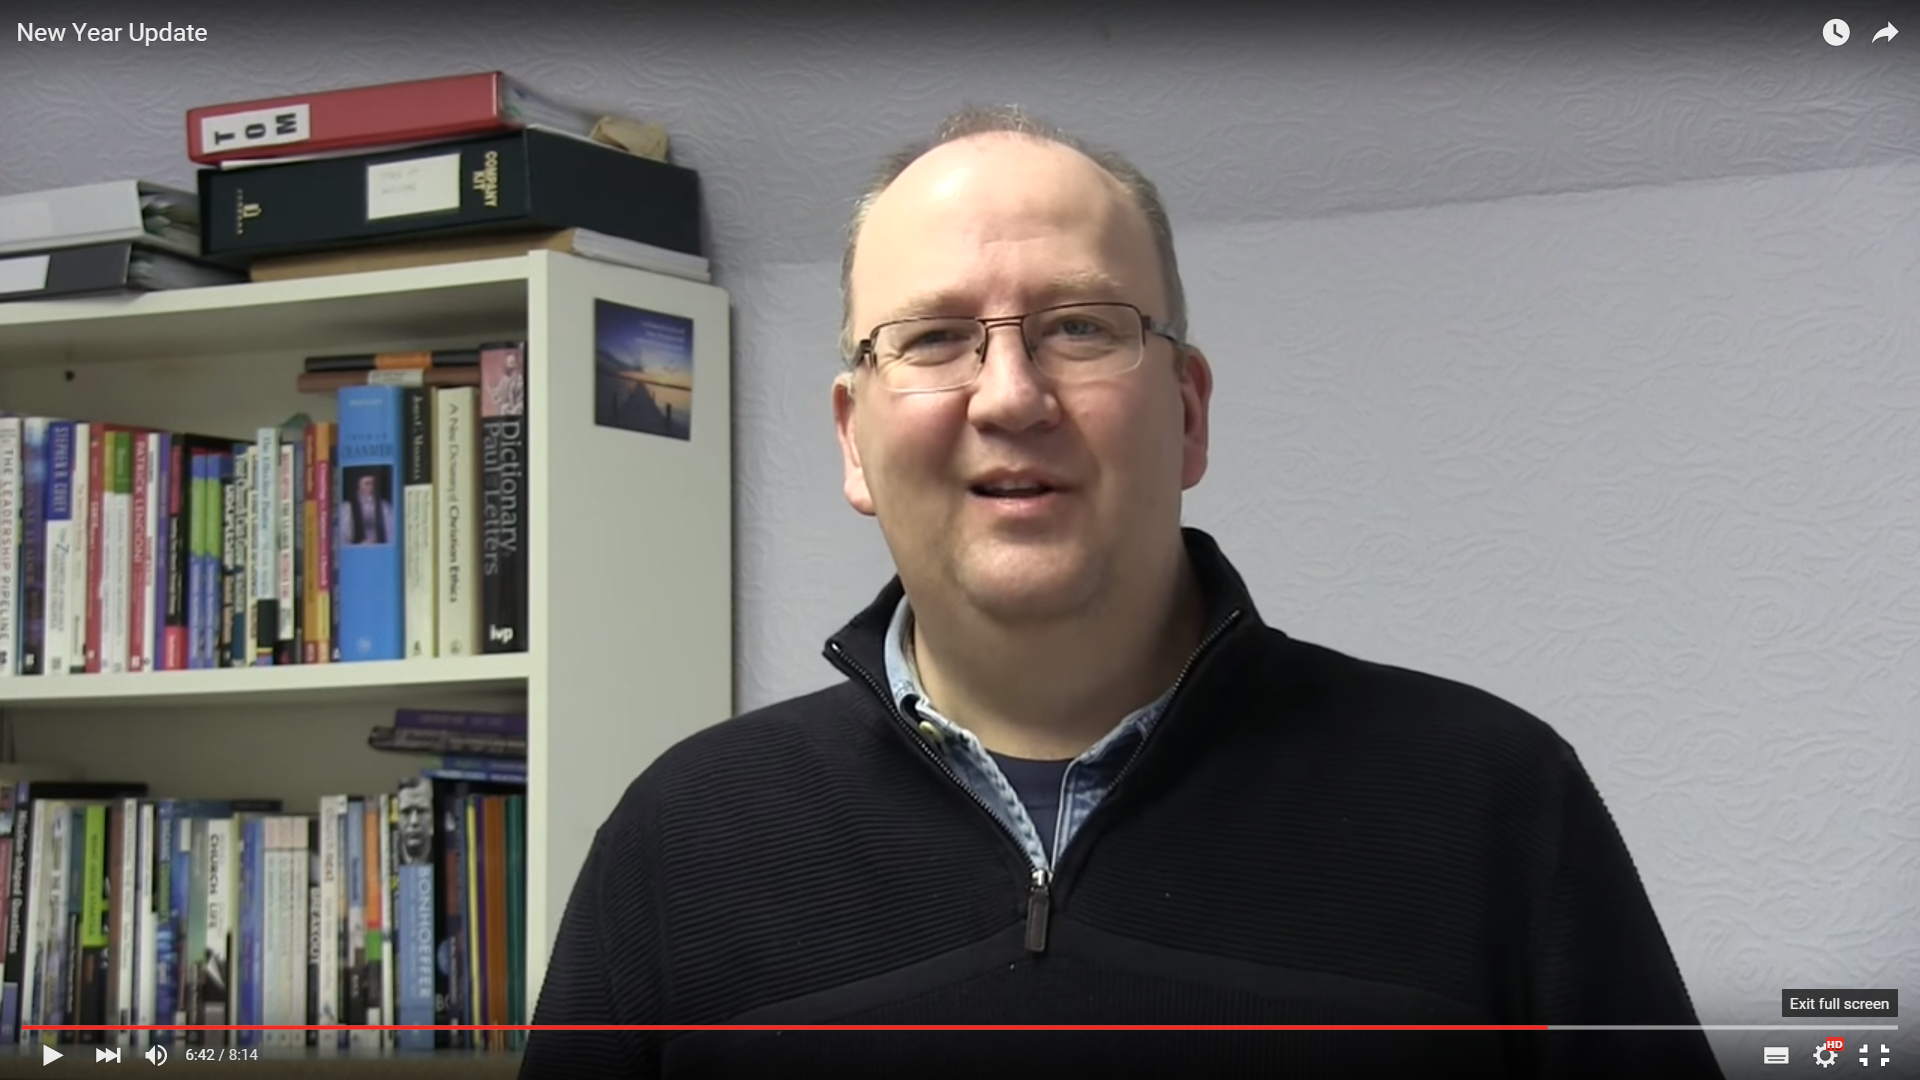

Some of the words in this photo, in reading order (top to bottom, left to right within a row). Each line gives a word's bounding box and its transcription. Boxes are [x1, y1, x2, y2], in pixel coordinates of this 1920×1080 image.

[473, 170, 485, 191] KIT
[485, 150, 499, 207] COMPANY
[448, 417, 460, 441] New
[449, 403, 460, 417] A
[3, 448, 14, 475] THE
[54, 427, 70, 469] STEPHEN
[135, 441, 147, 494] PATRICK
[446, 444, 459, 494] Dictionary
[483, 422, 502, 473] Paul
[54, 482, 69, 514] COVEY
[234, 479, 247, 515] Church
[261, 455, 272, 497] Effective
[498, 421, 522, 550] Dictionary
[2, 480, 13, 570] LEADERSHIP
[56, 541, 70, 555] 7
[134, 498, 145, 564] LENCIONI
[448, 505, 460, 564] Christian
[483, 490, 502, 576] Letters
[0, 575, 11, 640] PIPELINE
[449, 565, 461, 603] Ethics
[489, 624, 515, 646] ivp
[12, 809, 28, 896] Mission-shaped
[209, 833, 220, 895] CHURCH
[9, 897, 23, 954] Questions
[209, 901, 219, 929] LIFE
[309, 886, 321, 965] BREAKOUT
[419, 866, 432, 998] BONHOEFFER
